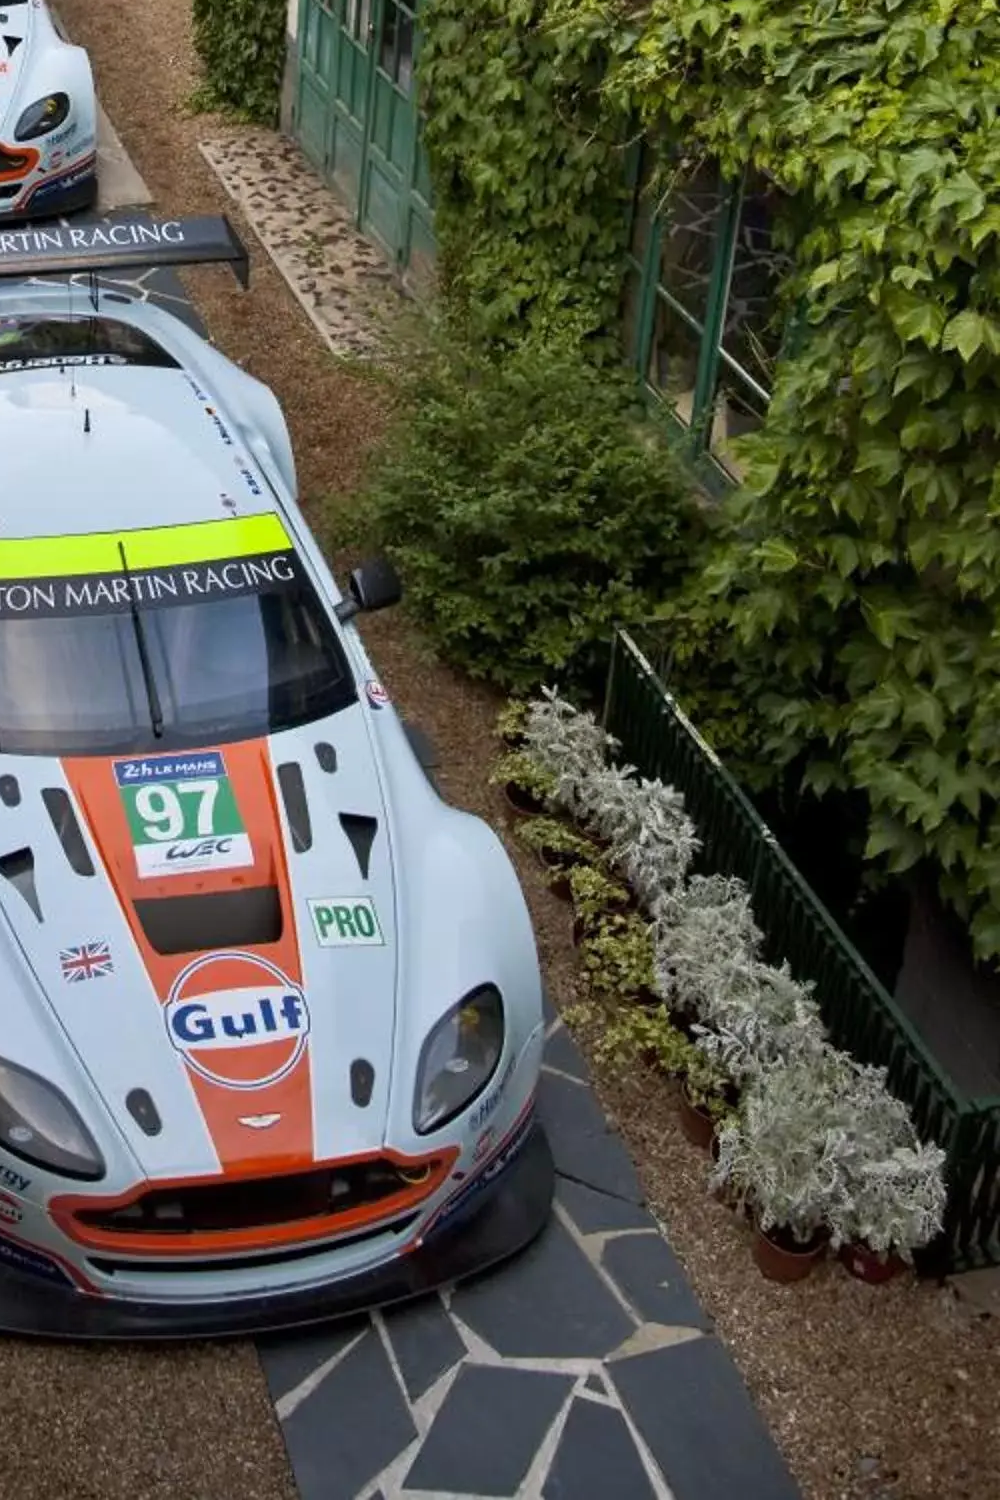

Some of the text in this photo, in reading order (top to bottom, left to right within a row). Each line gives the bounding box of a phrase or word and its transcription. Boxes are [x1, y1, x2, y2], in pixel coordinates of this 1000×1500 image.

[69, 221, 185, 248] RACING
[65, 573, 178, 607] MARTIN
[182, 556, 295, 595] RACING
[155, 763, 173, 773] LE
[175, 760, 217, 773] MANS
[135, 780, 219, 841] 97
[165, 838, 233, 861] WEC
[314, 904, 376, 938] PRO
[170, 995, 302, 1043] Gulf
